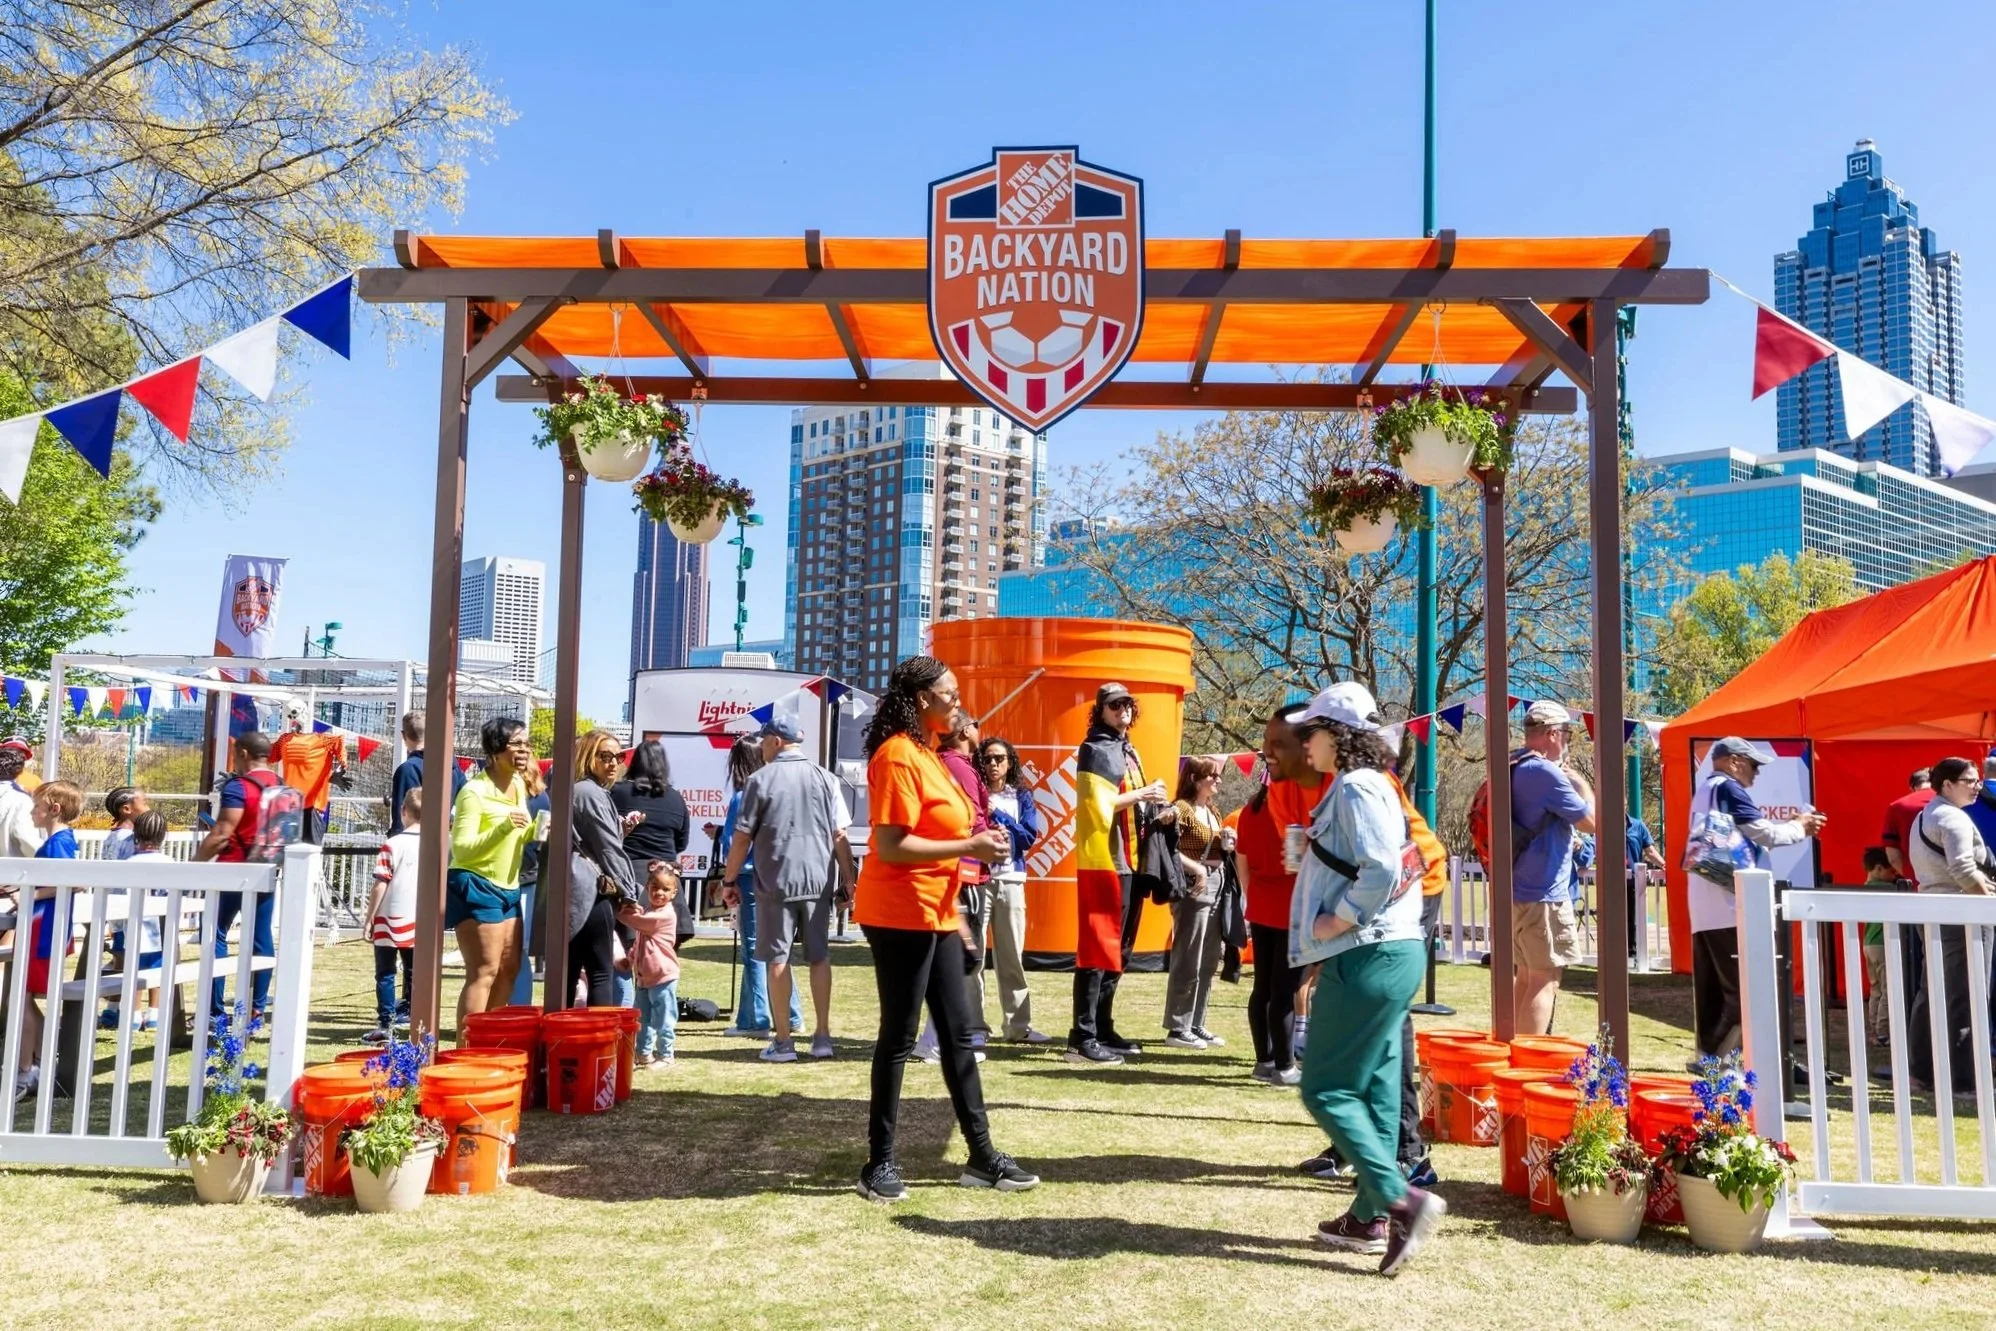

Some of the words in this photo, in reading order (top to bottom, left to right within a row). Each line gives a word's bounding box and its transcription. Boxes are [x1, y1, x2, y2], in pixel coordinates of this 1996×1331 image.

[1000, 153, 1072, 226] HOME
[1006, 161, 1037, 190] THE
[1027, 179, 1072, 225] DEPOT
[944, 231, 1128, 280] BACKYARD
[977, 271, 1095, 310] NATION
[698, 700, 756, 726] Lightni
[681, 789, 723, 802] ALTIES
[1759, 805, 1798, 820] CKED
[1026, 815, 1077, 877] DEP
